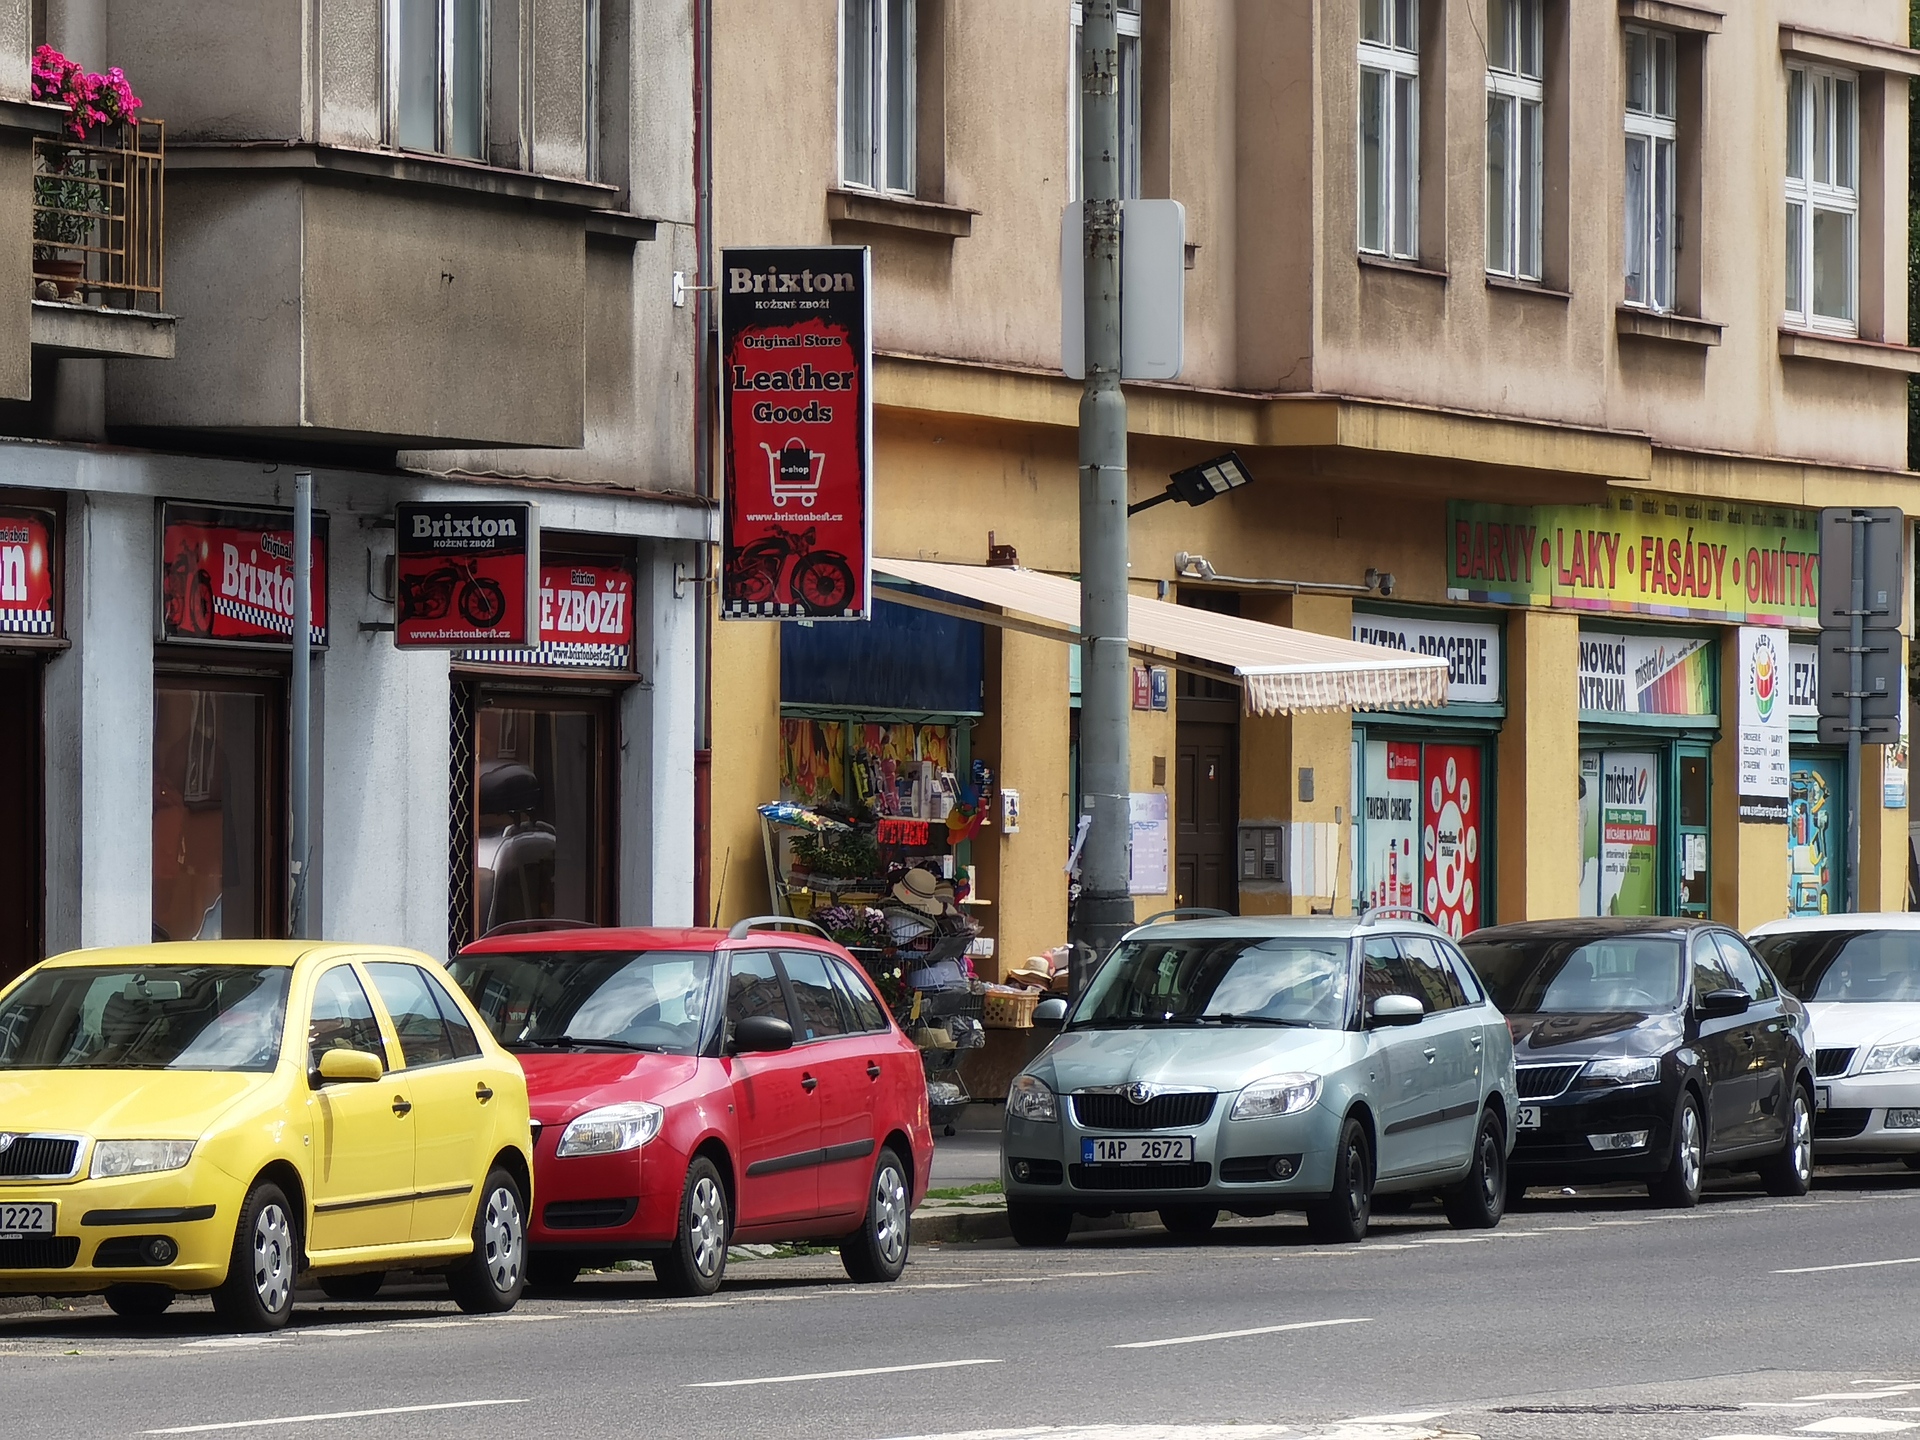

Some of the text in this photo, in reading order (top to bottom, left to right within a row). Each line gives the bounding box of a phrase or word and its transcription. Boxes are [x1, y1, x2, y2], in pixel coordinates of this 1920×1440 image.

[729, 266, 856, 294] Brixton
[755, 299, 830, 310] KOŽENÉ ZBOŽÍ
[742, 335, 842, 351] Original Store
[733, 364, 854, 391] Leather
[753, 400, 833, 424] Goods
[780, 465, 810, 476] e-shop
[412, 513, 517, 537] Brixton
[746, 511, 843, 523] www.brixtonbest.cz
[262, 533, 294, 560] Original
[433, 537, 495, 548] KOŽENÉ ZBOŽÍ
[1455, 520, 1819, 608] BARVY LAKY FASÁDY OMÍTK
[222, 542, 312, 622] Brixto
[571, 570, 594, 587] Brixton
[558, 580, 627, 634] ZBOŽÍ
[410, 628, 512, 640] www.brixtonbest.cz
[1604, 765, 1638, 806] mistral
[1098, 1140, 1183, 1160] 1AP 2672
